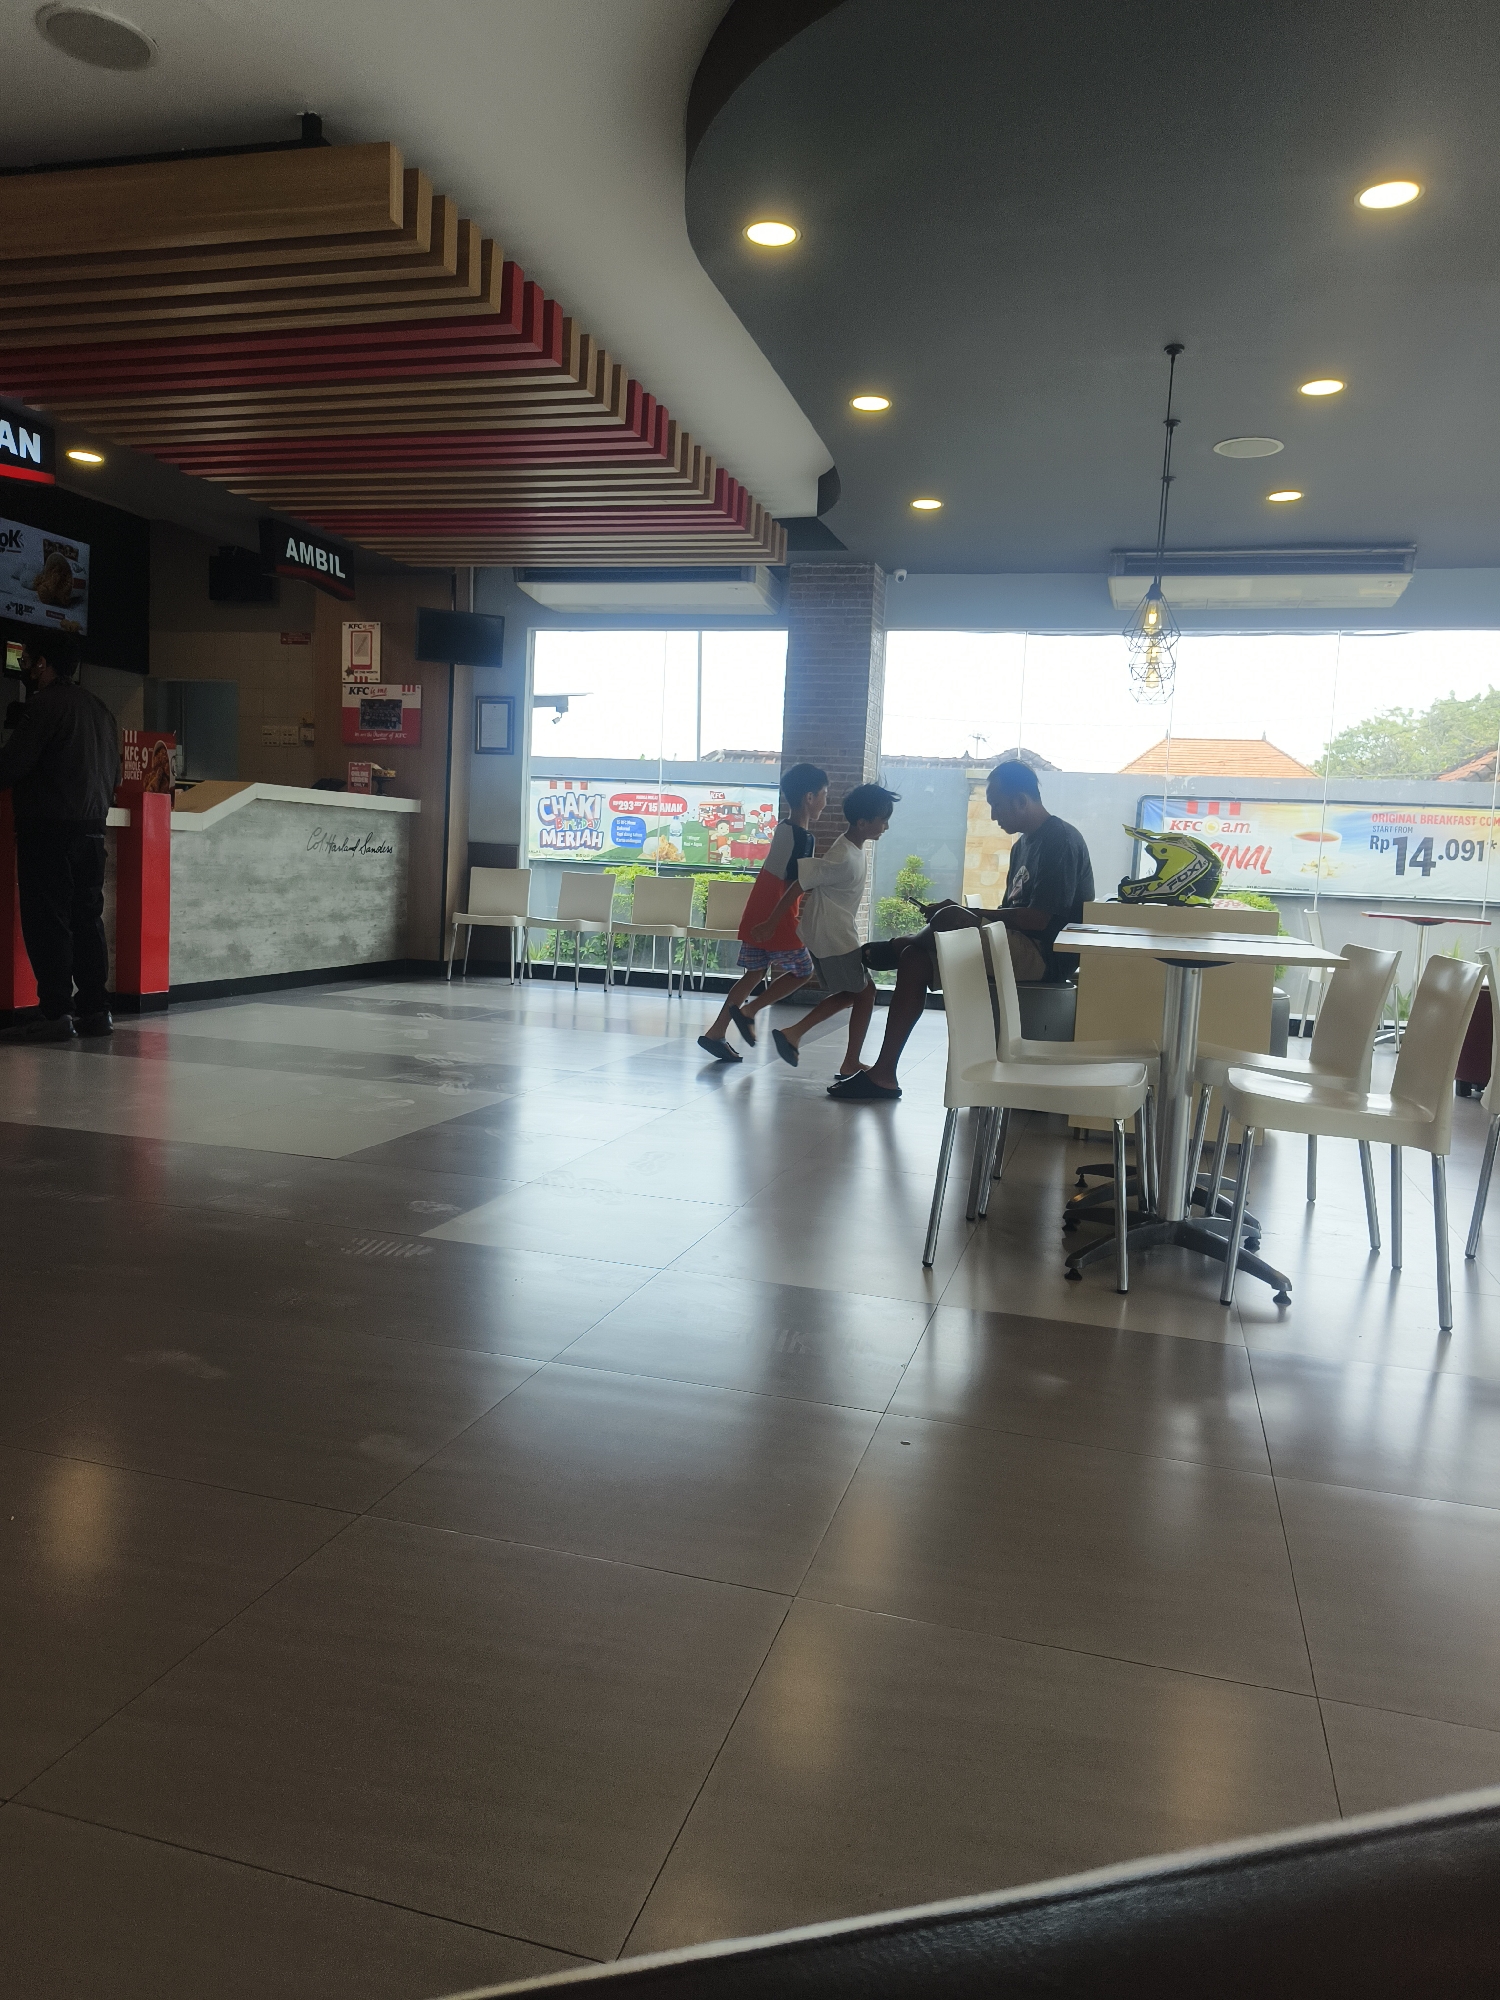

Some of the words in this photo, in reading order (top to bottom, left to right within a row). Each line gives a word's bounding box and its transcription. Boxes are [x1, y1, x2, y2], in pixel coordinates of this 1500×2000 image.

[0, 419, 41, 464] AN
[286, 537, 346, 579] AMBIL
[349, 687, 370, 695] KFC
[124, 746, 139, 761] KFC
[124, 761, 141, 771] WHOLE
[124, 771, 143, 780] BUCKET
[538, 792, 602, 824] CHAKI
[659, 804, 683, 813] ANAK
[1371, 813, 1418, 824] ORIGINAL
[1420, 814, 1477, 826] BREAKFAST
[1169, 820, 1203, 832] KFC
[1221, 821, 1252, 834] a.m.
[1372, 825, 1393, 833] START
[1394, 825, 1413, 834] FROM
[325, 834, 360, 857] Harland
[359, 832, 393, 855] Sanders
[541, 829, 604, 849] MERIAH
